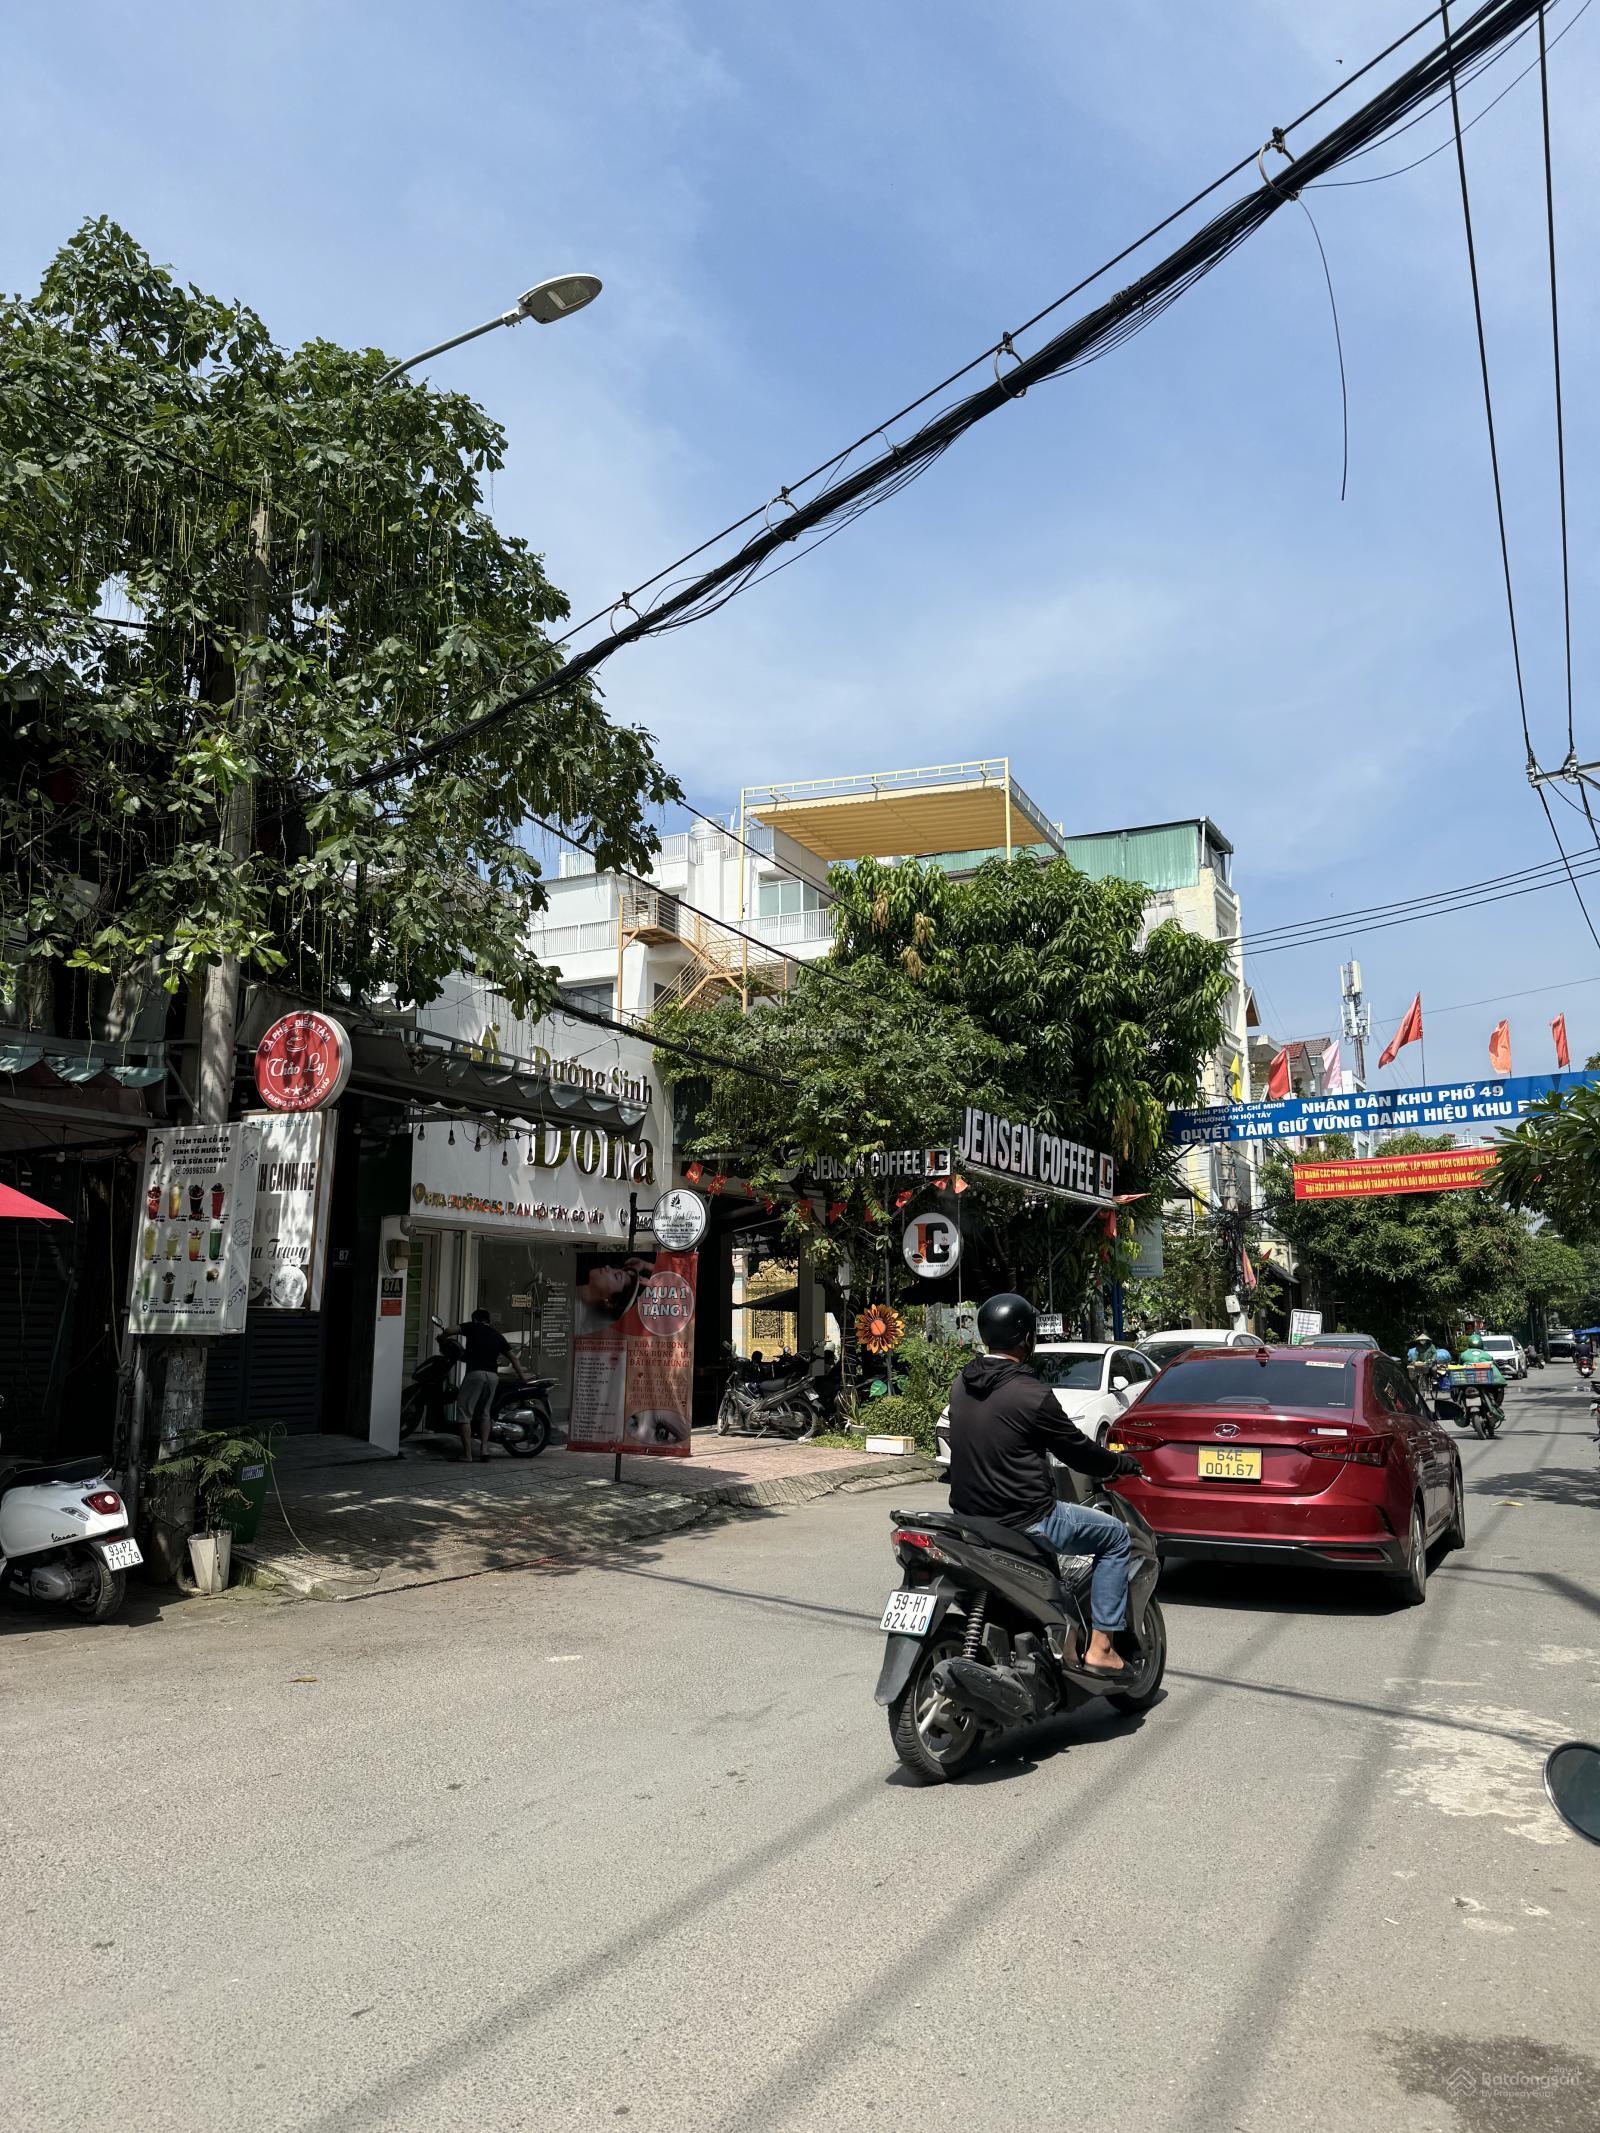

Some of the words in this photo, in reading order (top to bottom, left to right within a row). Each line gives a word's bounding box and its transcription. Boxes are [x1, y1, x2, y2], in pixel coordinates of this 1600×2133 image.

[264, 1039, 274, 1052] CÀ
[272, 1022, 290, 1040] PHÊ
[316, 1025, 331, 1042] TÂM
[268, 1058, 301, 1077] Thảo
[303, 1053, 325, 1078] Ly
[610, 1066, 654, 1105] Sinh
[1301, 1098, 1350, 1114] NHÂN
[1355, 1094, 1391, 1109] DÂN
[1396, 1090, 1434, 1106] KHU
[1438, 1083, 1476, 1102] PHỐ
[1479, 1085, 1504, 1098] 49
[1184, 1109, 1211, 1118] THÀNH
[1212, 1104, 1230, 1115] PHỐ
[1231, 1102, 1244, 1113] HỒ
[1246, 1101, 1262, 1111] CHÍ
[1263, 1102, 1286, 1110] MINH
[1193, 1114, 1227, 1125] PHƯỜNG
[1241, 1112, 1256, 1123] HỘI
[1257, 1111, 1272, 1119] TÂY
[1180, 1122, 1231, 1143] QUYẾT
[1236, 1120, 1273, 1137] TÂM
[1278, 1116, 1310, 1133] GIỮ
[1311, 1113, 1362, 1131] VỮNG
[1367, 1109, 1419, 1127] DANH
[1424, 1104, 1468, 1123] HIỆU
[1472, 1100, 1513, 1118] KHU
[191, 1145, 200, 1154] TỐ
[201, 1145, 220, 1154] NƯỚC
[221, 1143, 231, 1153] ÉP
[193, 1134, 207, 1144] TRÀ
[208, 1134, 218, 1143] CÔ
[172, 1155, 187, 1165] TRÀ
[188, 1156, 203, 1165] SỮA
[526, 1126, 656, 1186] Dona
[958, 1107, 1036, 1177] JENSEN
[1038, 1132, 1095, 1194] COFFEE
[870, 1150, 921, 1177] COFFEE
[269, 1162, 300, 1192] CANH
[533, 1202, 549, 1223] HỘI
[573, 1206, 586, 1223] GÒ
[588, 1206, 605, 1225] VẤP
[383, 1278, 401, 1293] 87A
[644, 1286, 678, 1299] MUA
[681, 1286, 687, 1299] 1
[642, 1298, 680, 1321] TẶNG
[682, 1304, 689, 1317] 1
[1216, 1449, 1243, 1463] 64E
[1205, 1463, 1255, 1478] 001.67
[109, 1551, 141, 1569] 712.29
[893, 1594, 928, 1613] 59-H1
[883, 1612, 928, 1633] 824.40
